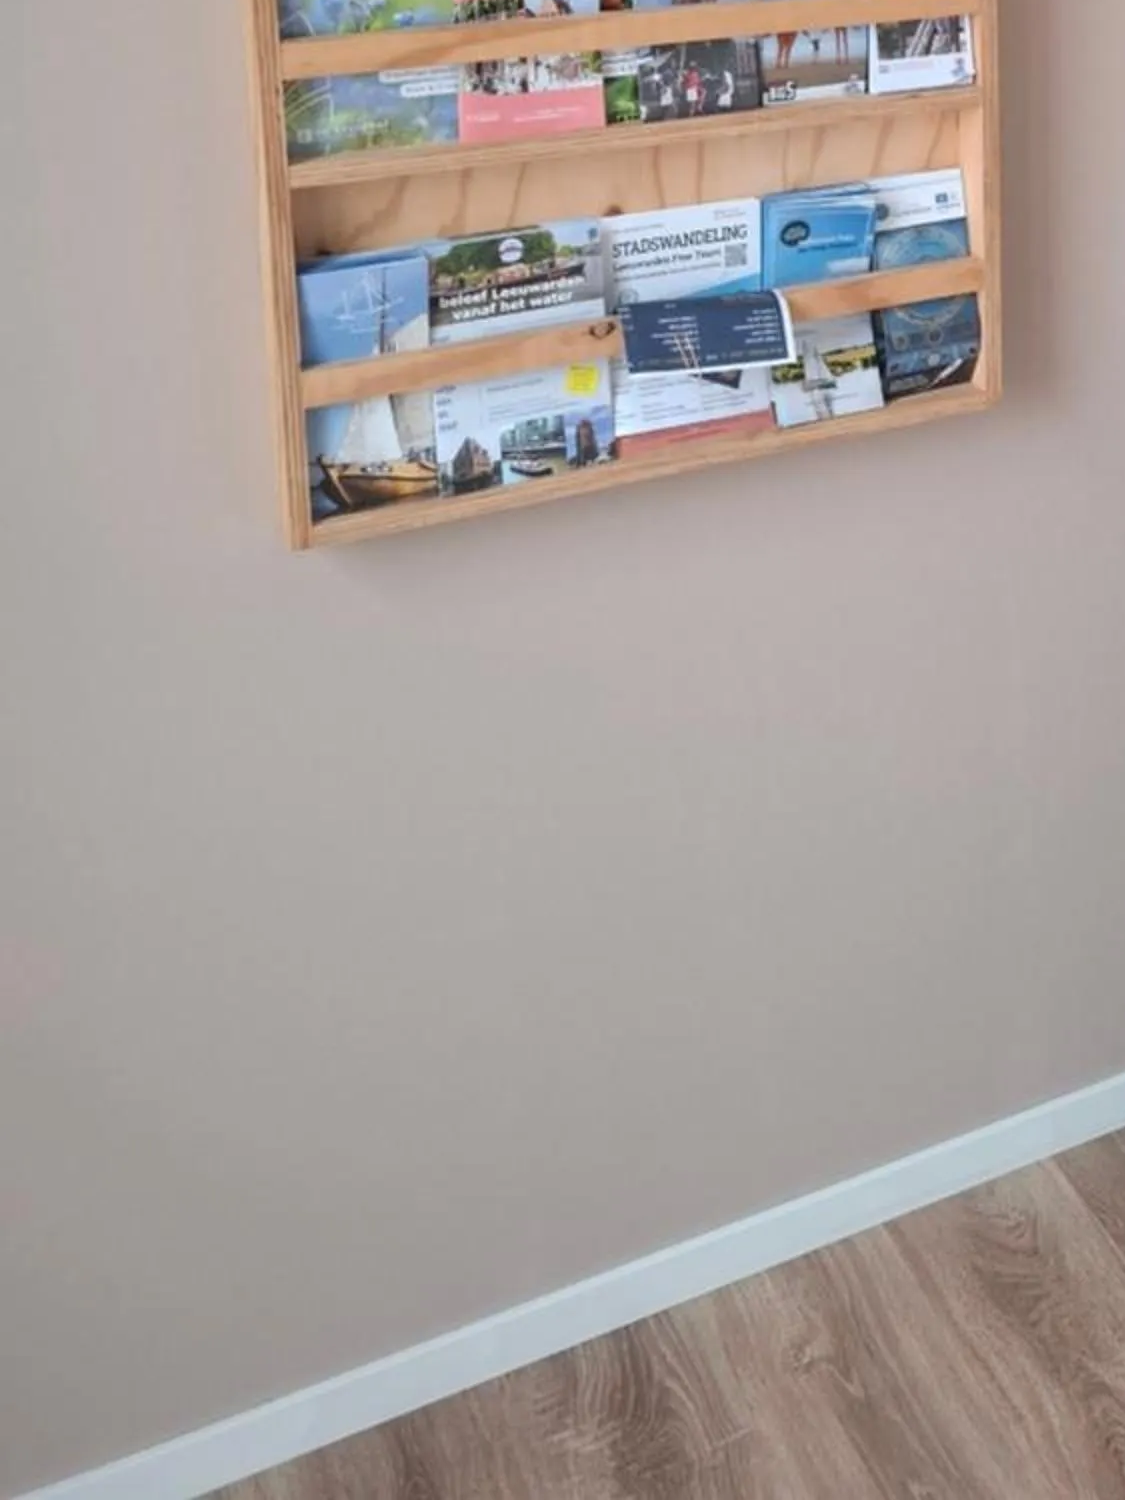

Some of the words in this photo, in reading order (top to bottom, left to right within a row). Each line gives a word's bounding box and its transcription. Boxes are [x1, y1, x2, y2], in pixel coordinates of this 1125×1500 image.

[611, 223, 748, 259] STADSWANDELING
[491, 275, 586, 300] Leeuwarden
[451, 302, 496, 321] vanaf
[500, 297, 525, 313] het
[530, 290, 573, 308] water
